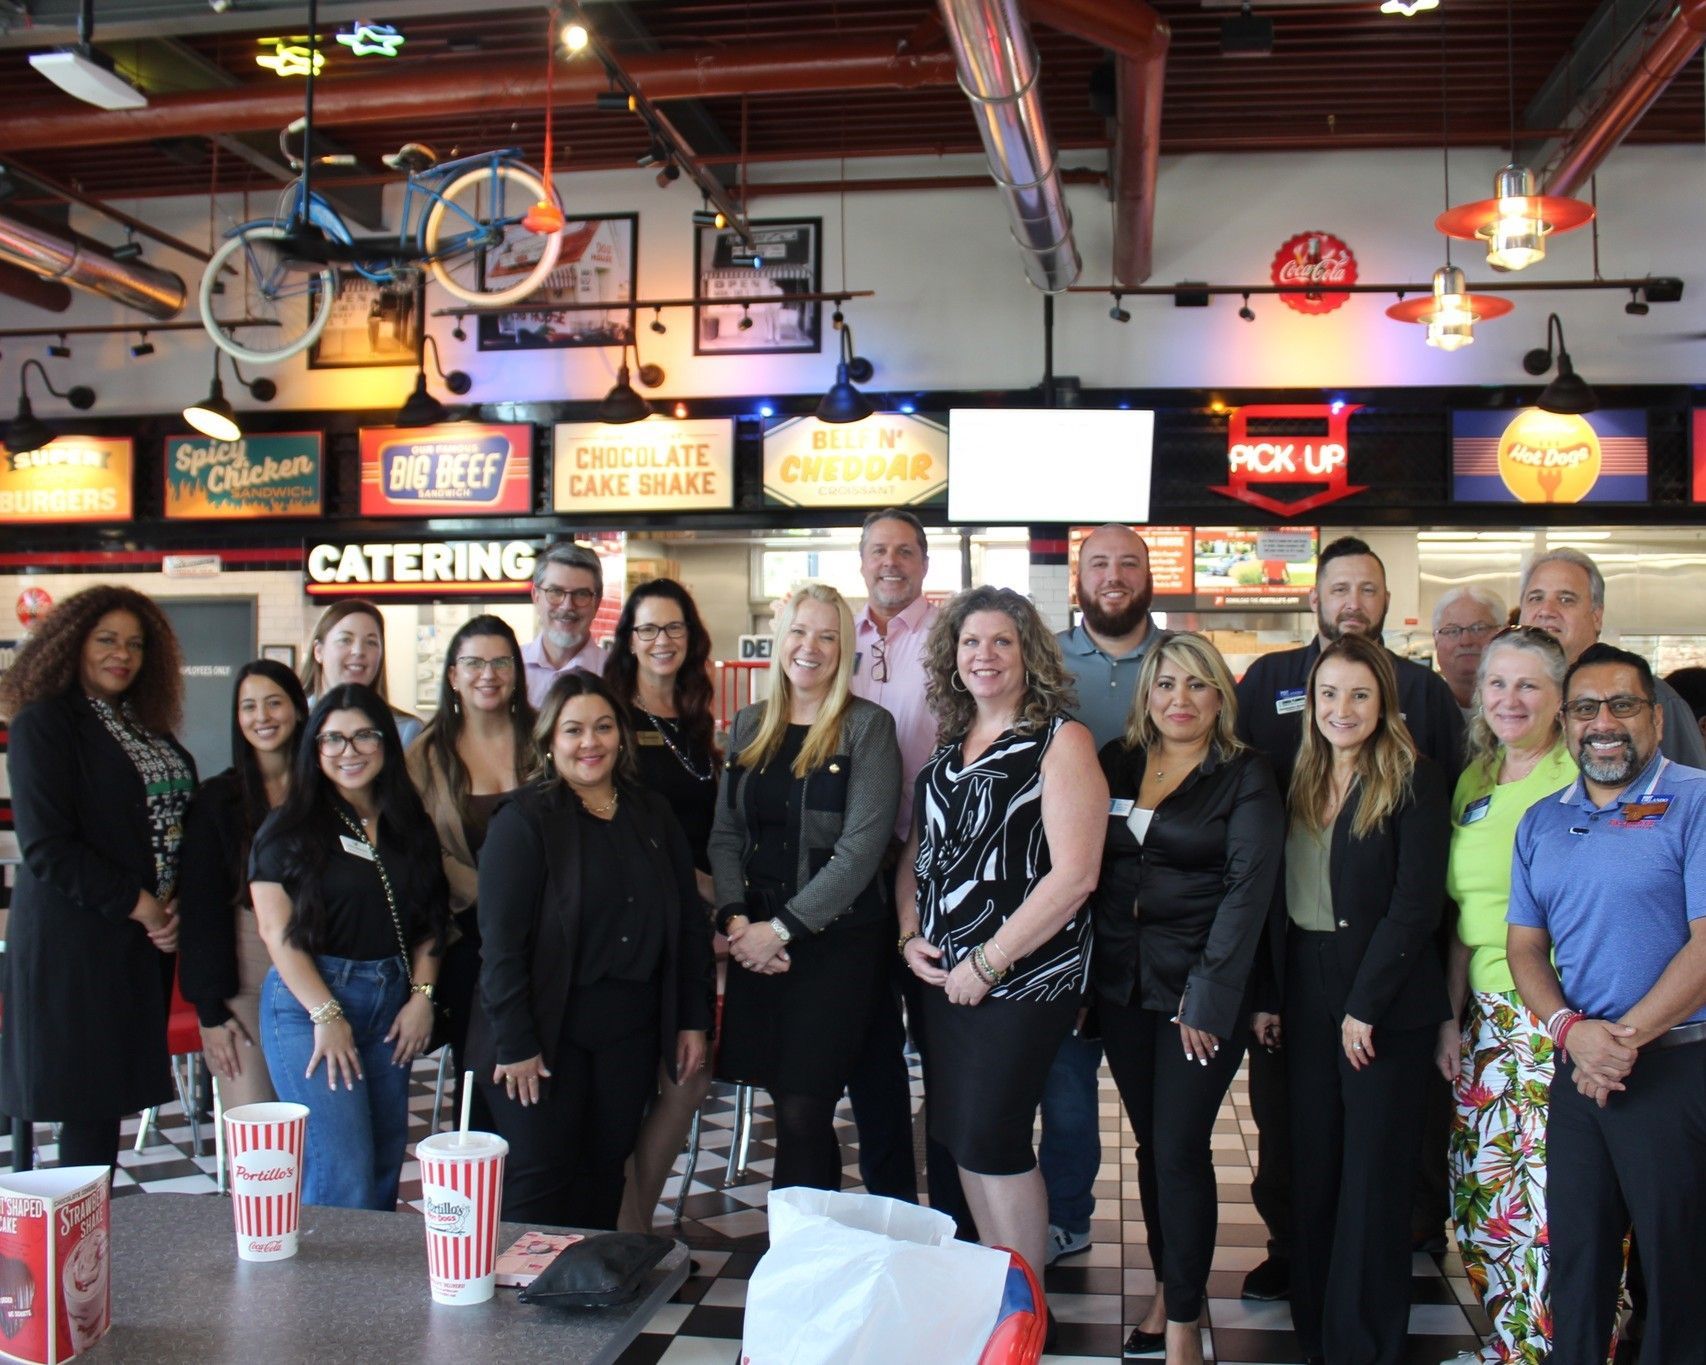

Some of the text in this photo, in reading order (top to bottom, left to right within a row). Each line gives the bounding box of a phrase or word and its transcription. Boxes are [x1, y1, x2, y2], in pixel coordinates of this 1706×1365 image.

[175, 440, 249, 477] Spicy
[576, 444, 710, 470] CHOCOLATE
[780, 453, 932, 483] CHEDDAR
[1230, 443, 1345, 474] PICK UP
[1509, 443, 1590, 468] Hot Dogs
[207, 455, 314, 493] Chicken
[390, 452, 501, 491] BIG BEEF
[231, 486, 312, 498] SANDWICH
[418, 489, 470, 498] SANDWICH
[569, 472, 716, 497] CAKE SHAKE
[818, 485, 895, 496] CROISSANT
[0, 488, 117, 513] BURGERS
[308, 541, 535, 583] CATERING
[236, 1165, 293, 1181] Portillo's
[7, 1197, 43, 1218] SHAPED
